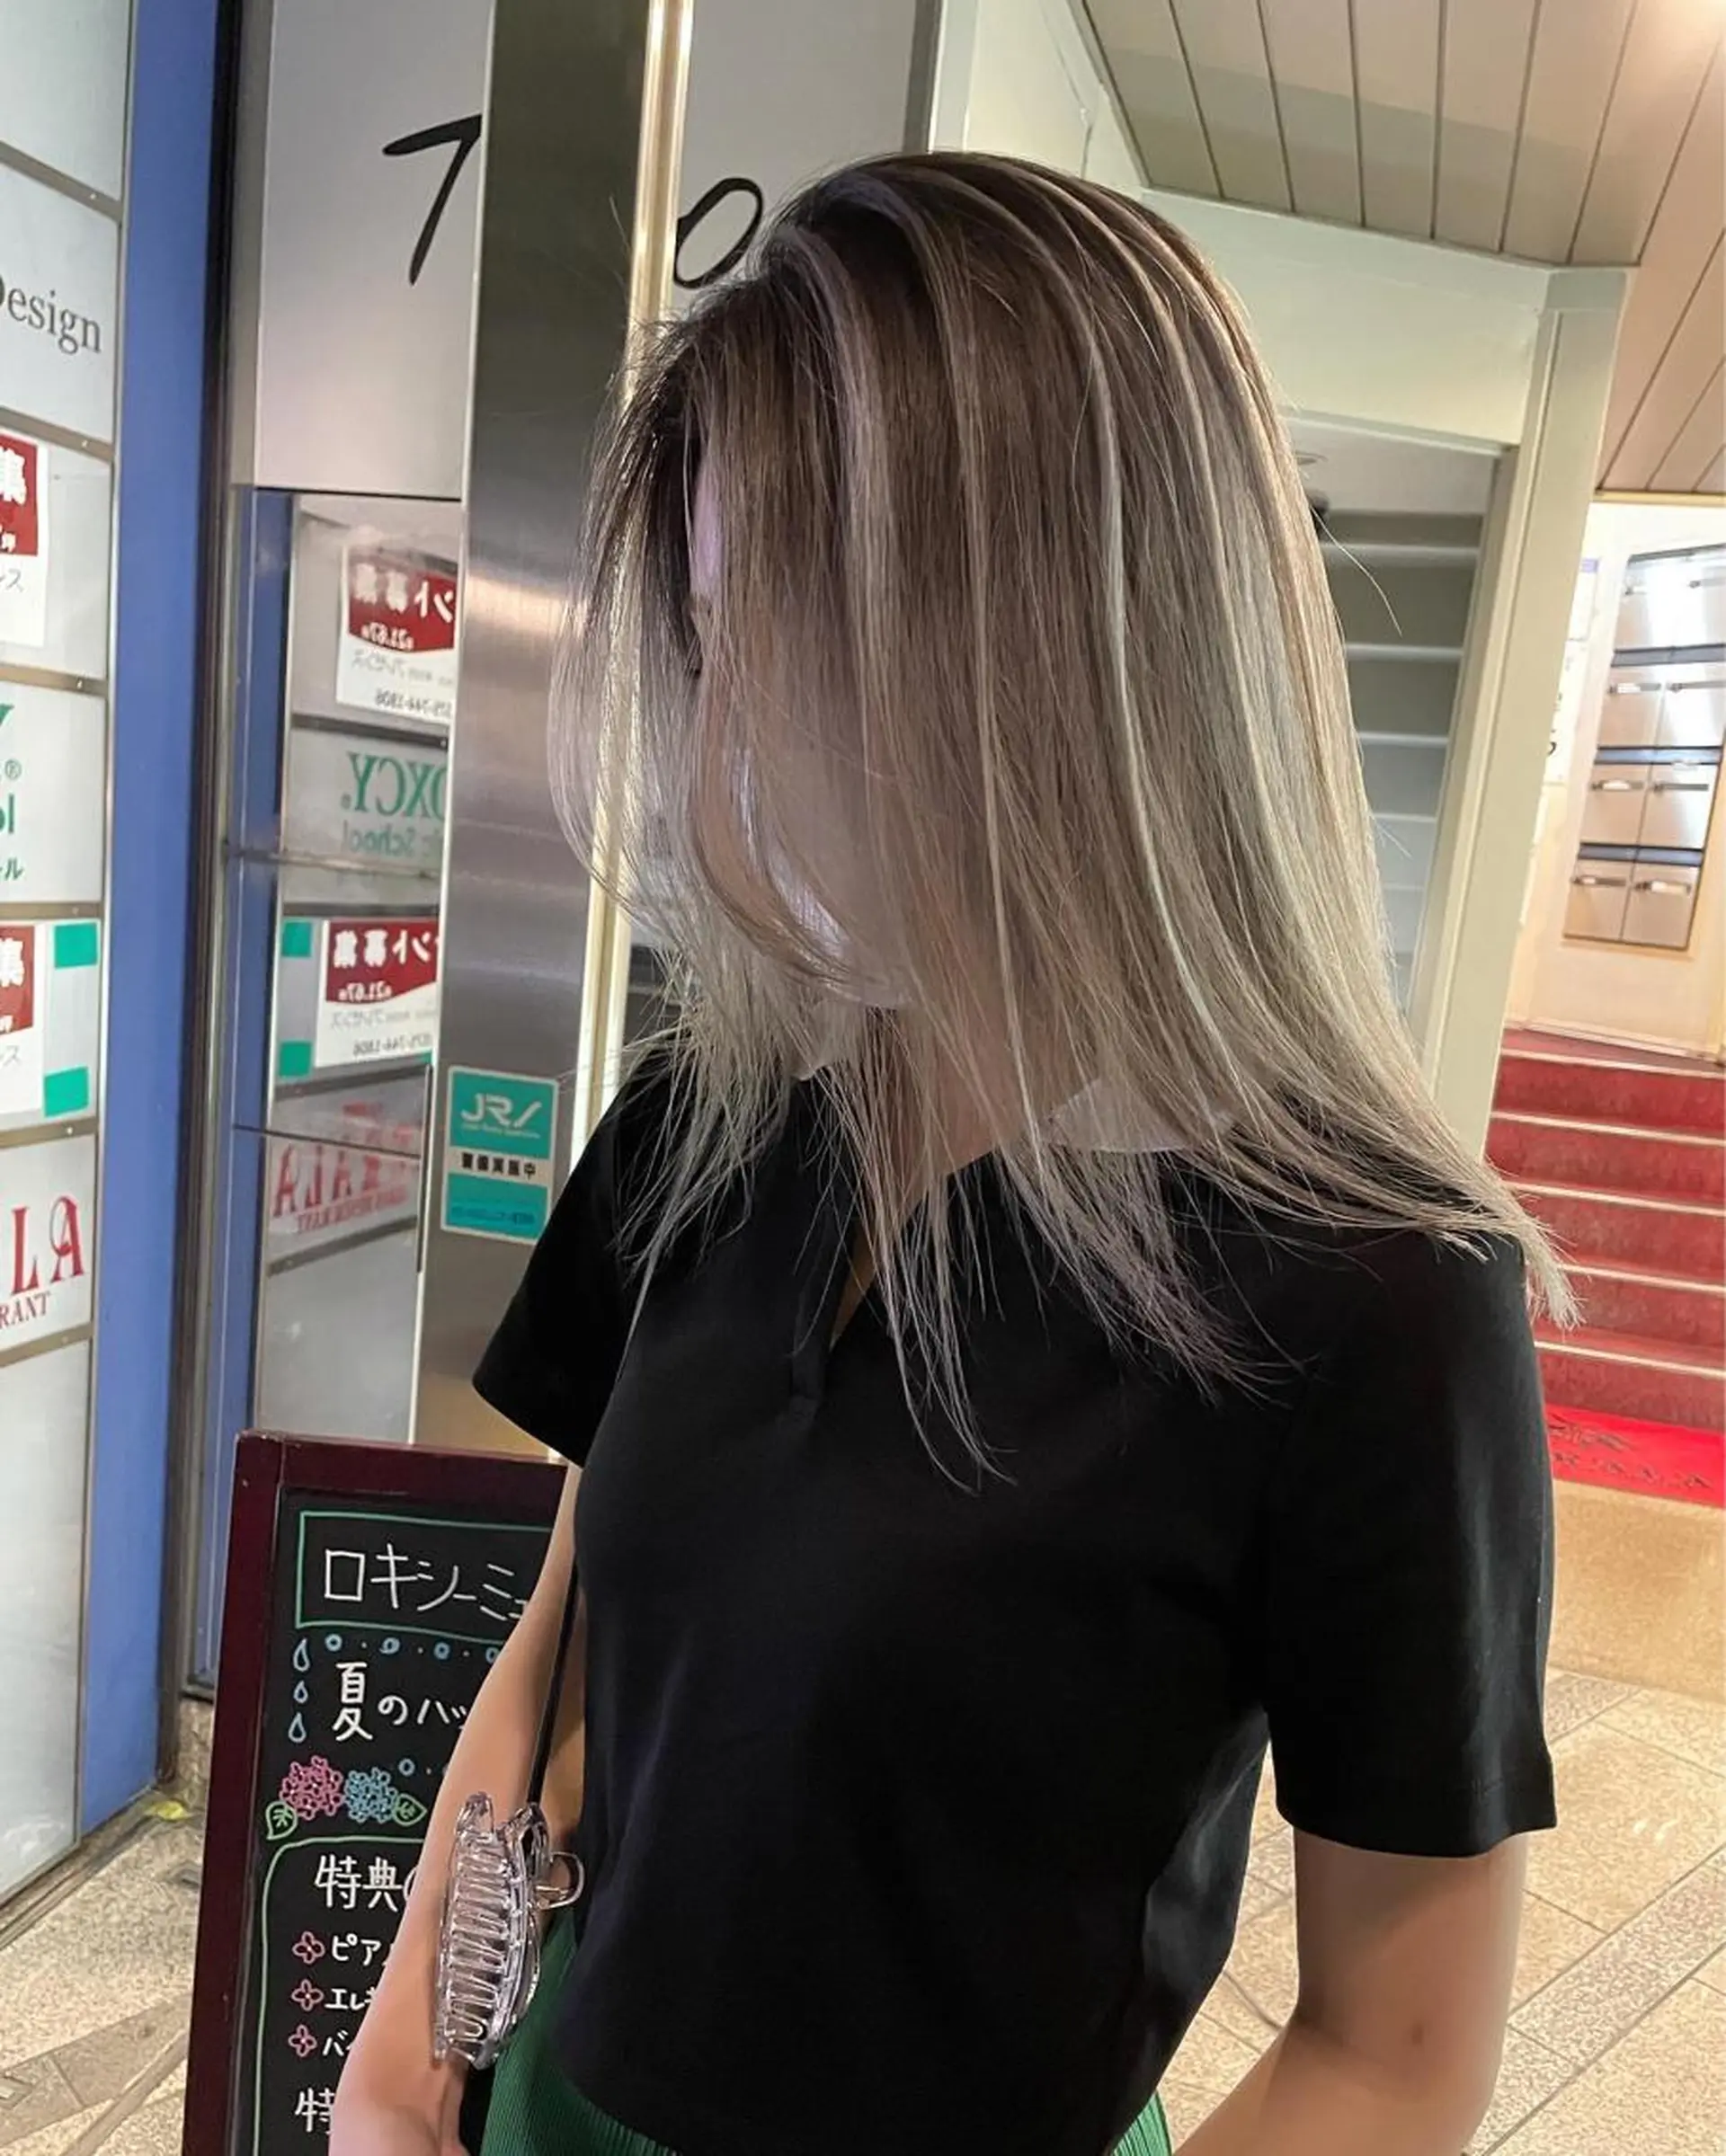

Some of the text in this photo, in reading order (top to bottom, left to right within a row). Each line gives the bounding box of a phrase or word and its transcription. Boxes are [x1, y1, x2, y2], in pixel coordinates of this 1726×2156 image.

[0, 273, 102, 354] esign
[331, 1932, 388, 1966] ピア
[322, 2029, 352, 2057] バ
